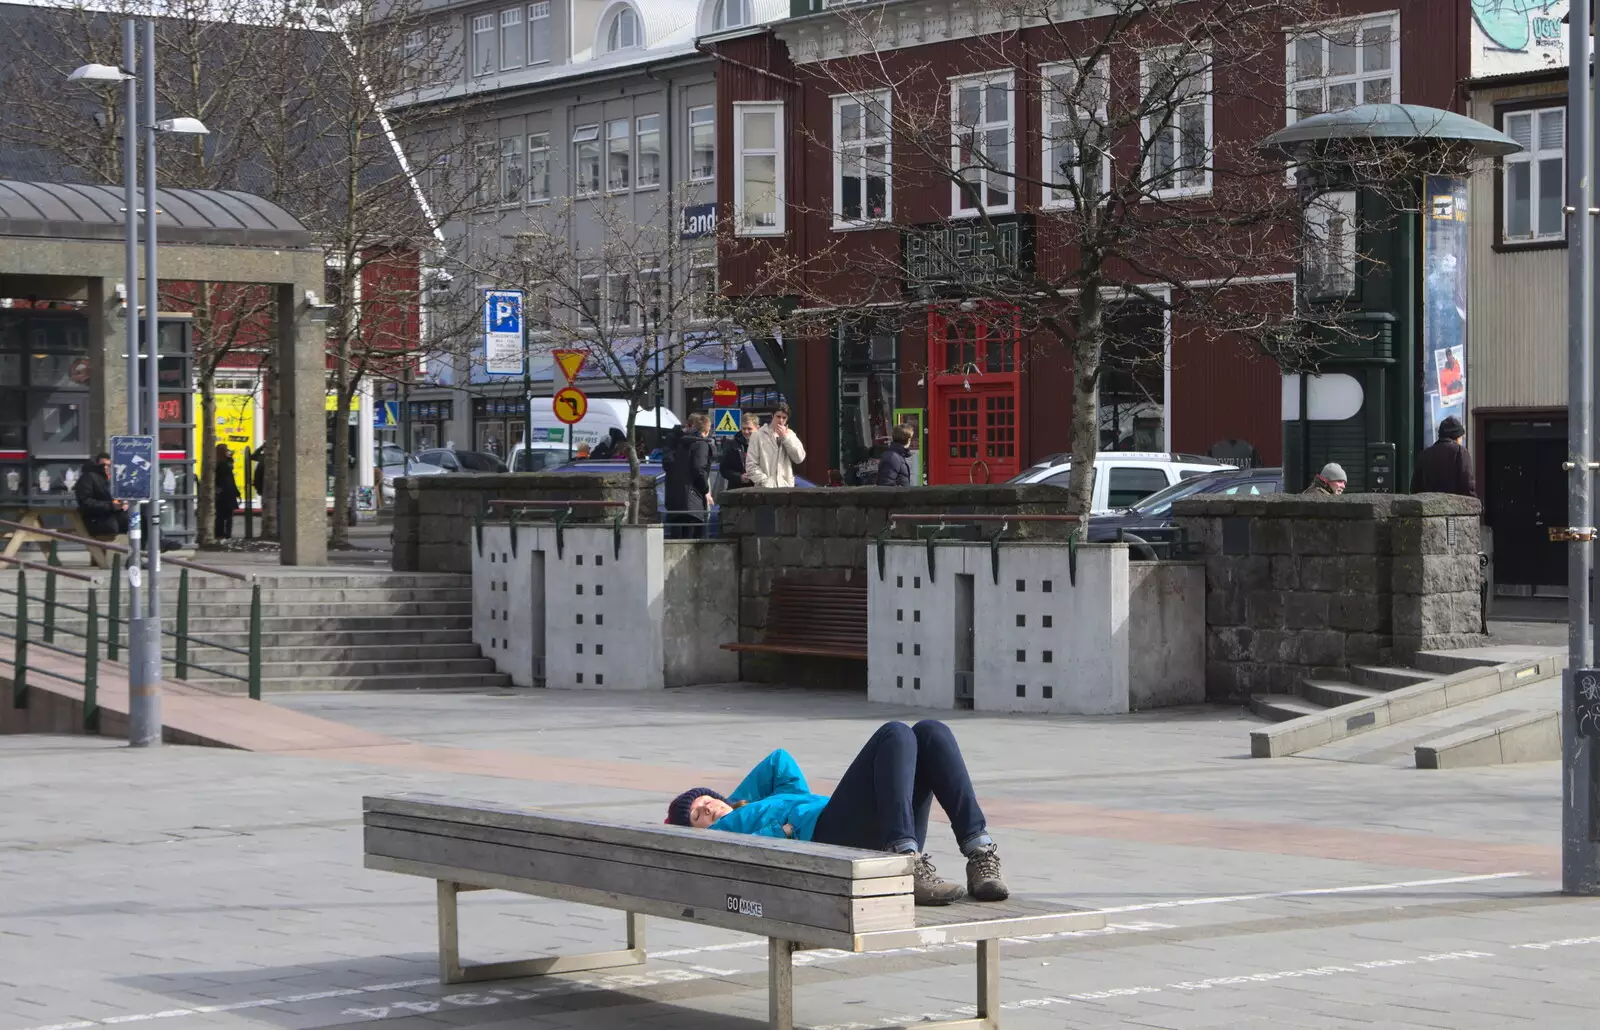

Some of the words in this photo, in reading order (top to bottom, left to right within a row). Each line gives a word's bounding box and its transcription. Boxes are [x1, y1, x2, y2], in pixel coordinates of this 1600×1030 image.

[680, 206, 718, 234] Land
[497, 302, 512, 326] P
[727, 896, 738, 911] GO
[739, 899, 763, 917] MAKE
